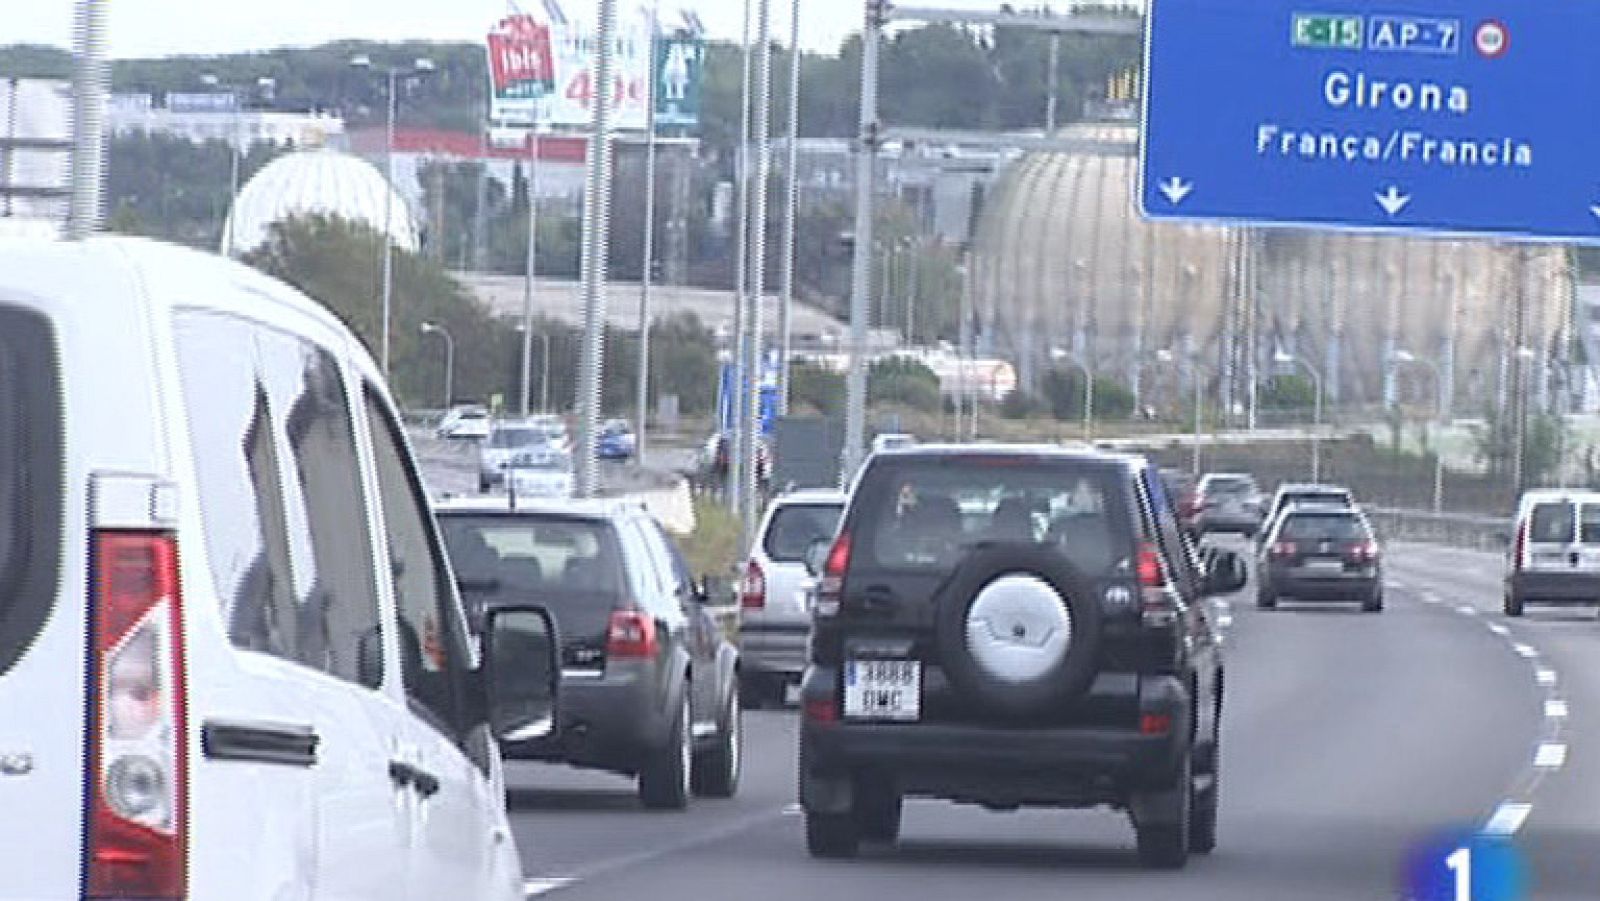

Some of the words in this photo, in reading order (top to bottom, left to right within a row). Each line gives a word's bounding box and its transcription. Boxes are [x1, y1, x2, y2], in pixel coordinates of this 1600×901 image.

[1296, 16, 1359, 47] E-15
[1374, 22, 1453, 48] AP-7
[1324, 72, 1469, 112] Girona
[1257, 124, 1532, 166] França/Francia
